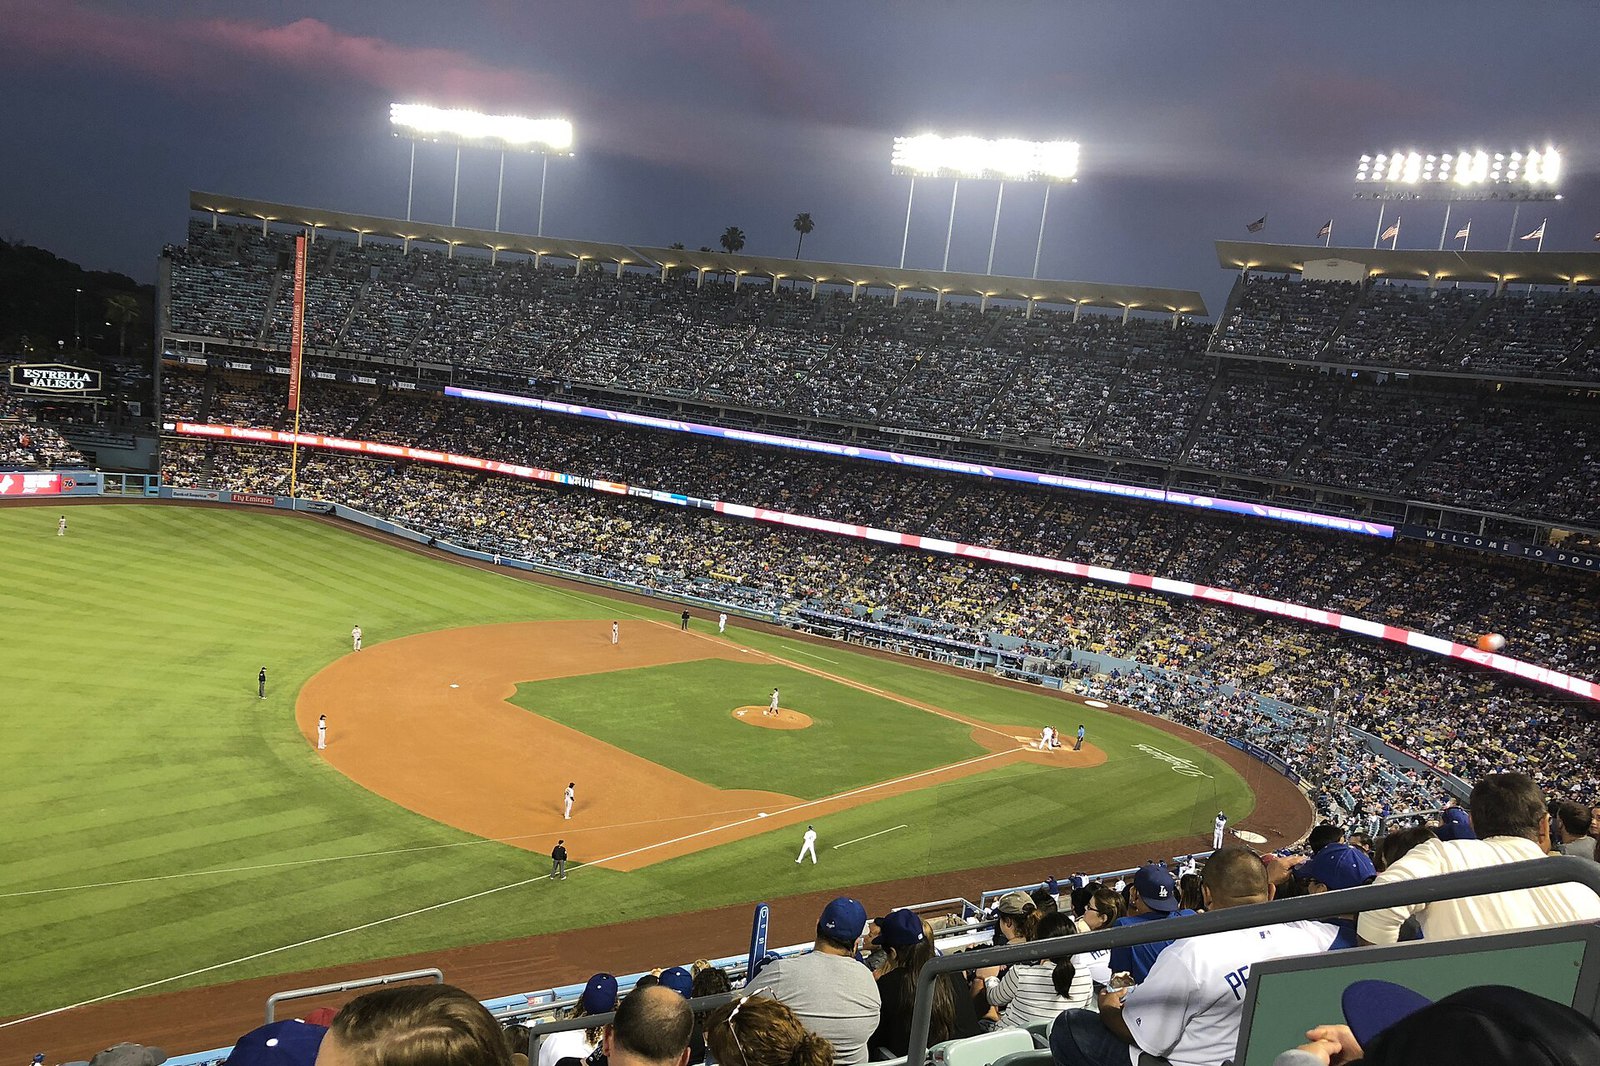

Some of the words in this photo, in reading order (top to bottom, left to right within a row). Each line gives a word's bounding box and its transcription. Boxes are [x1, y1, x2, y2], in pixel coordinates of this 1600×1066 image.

[23, 368, 92, 382] ESTRELLA
[30, 378, 84, 389] JALISCO
[245, 495, 273, 504] Emirates
[1426, 530, 1509, 551] WELCOME
[1524, 547, 1543, 557] TO
[1558, 554, 1600, 567] DOD
[1159, 886, 1168, 897] LA
